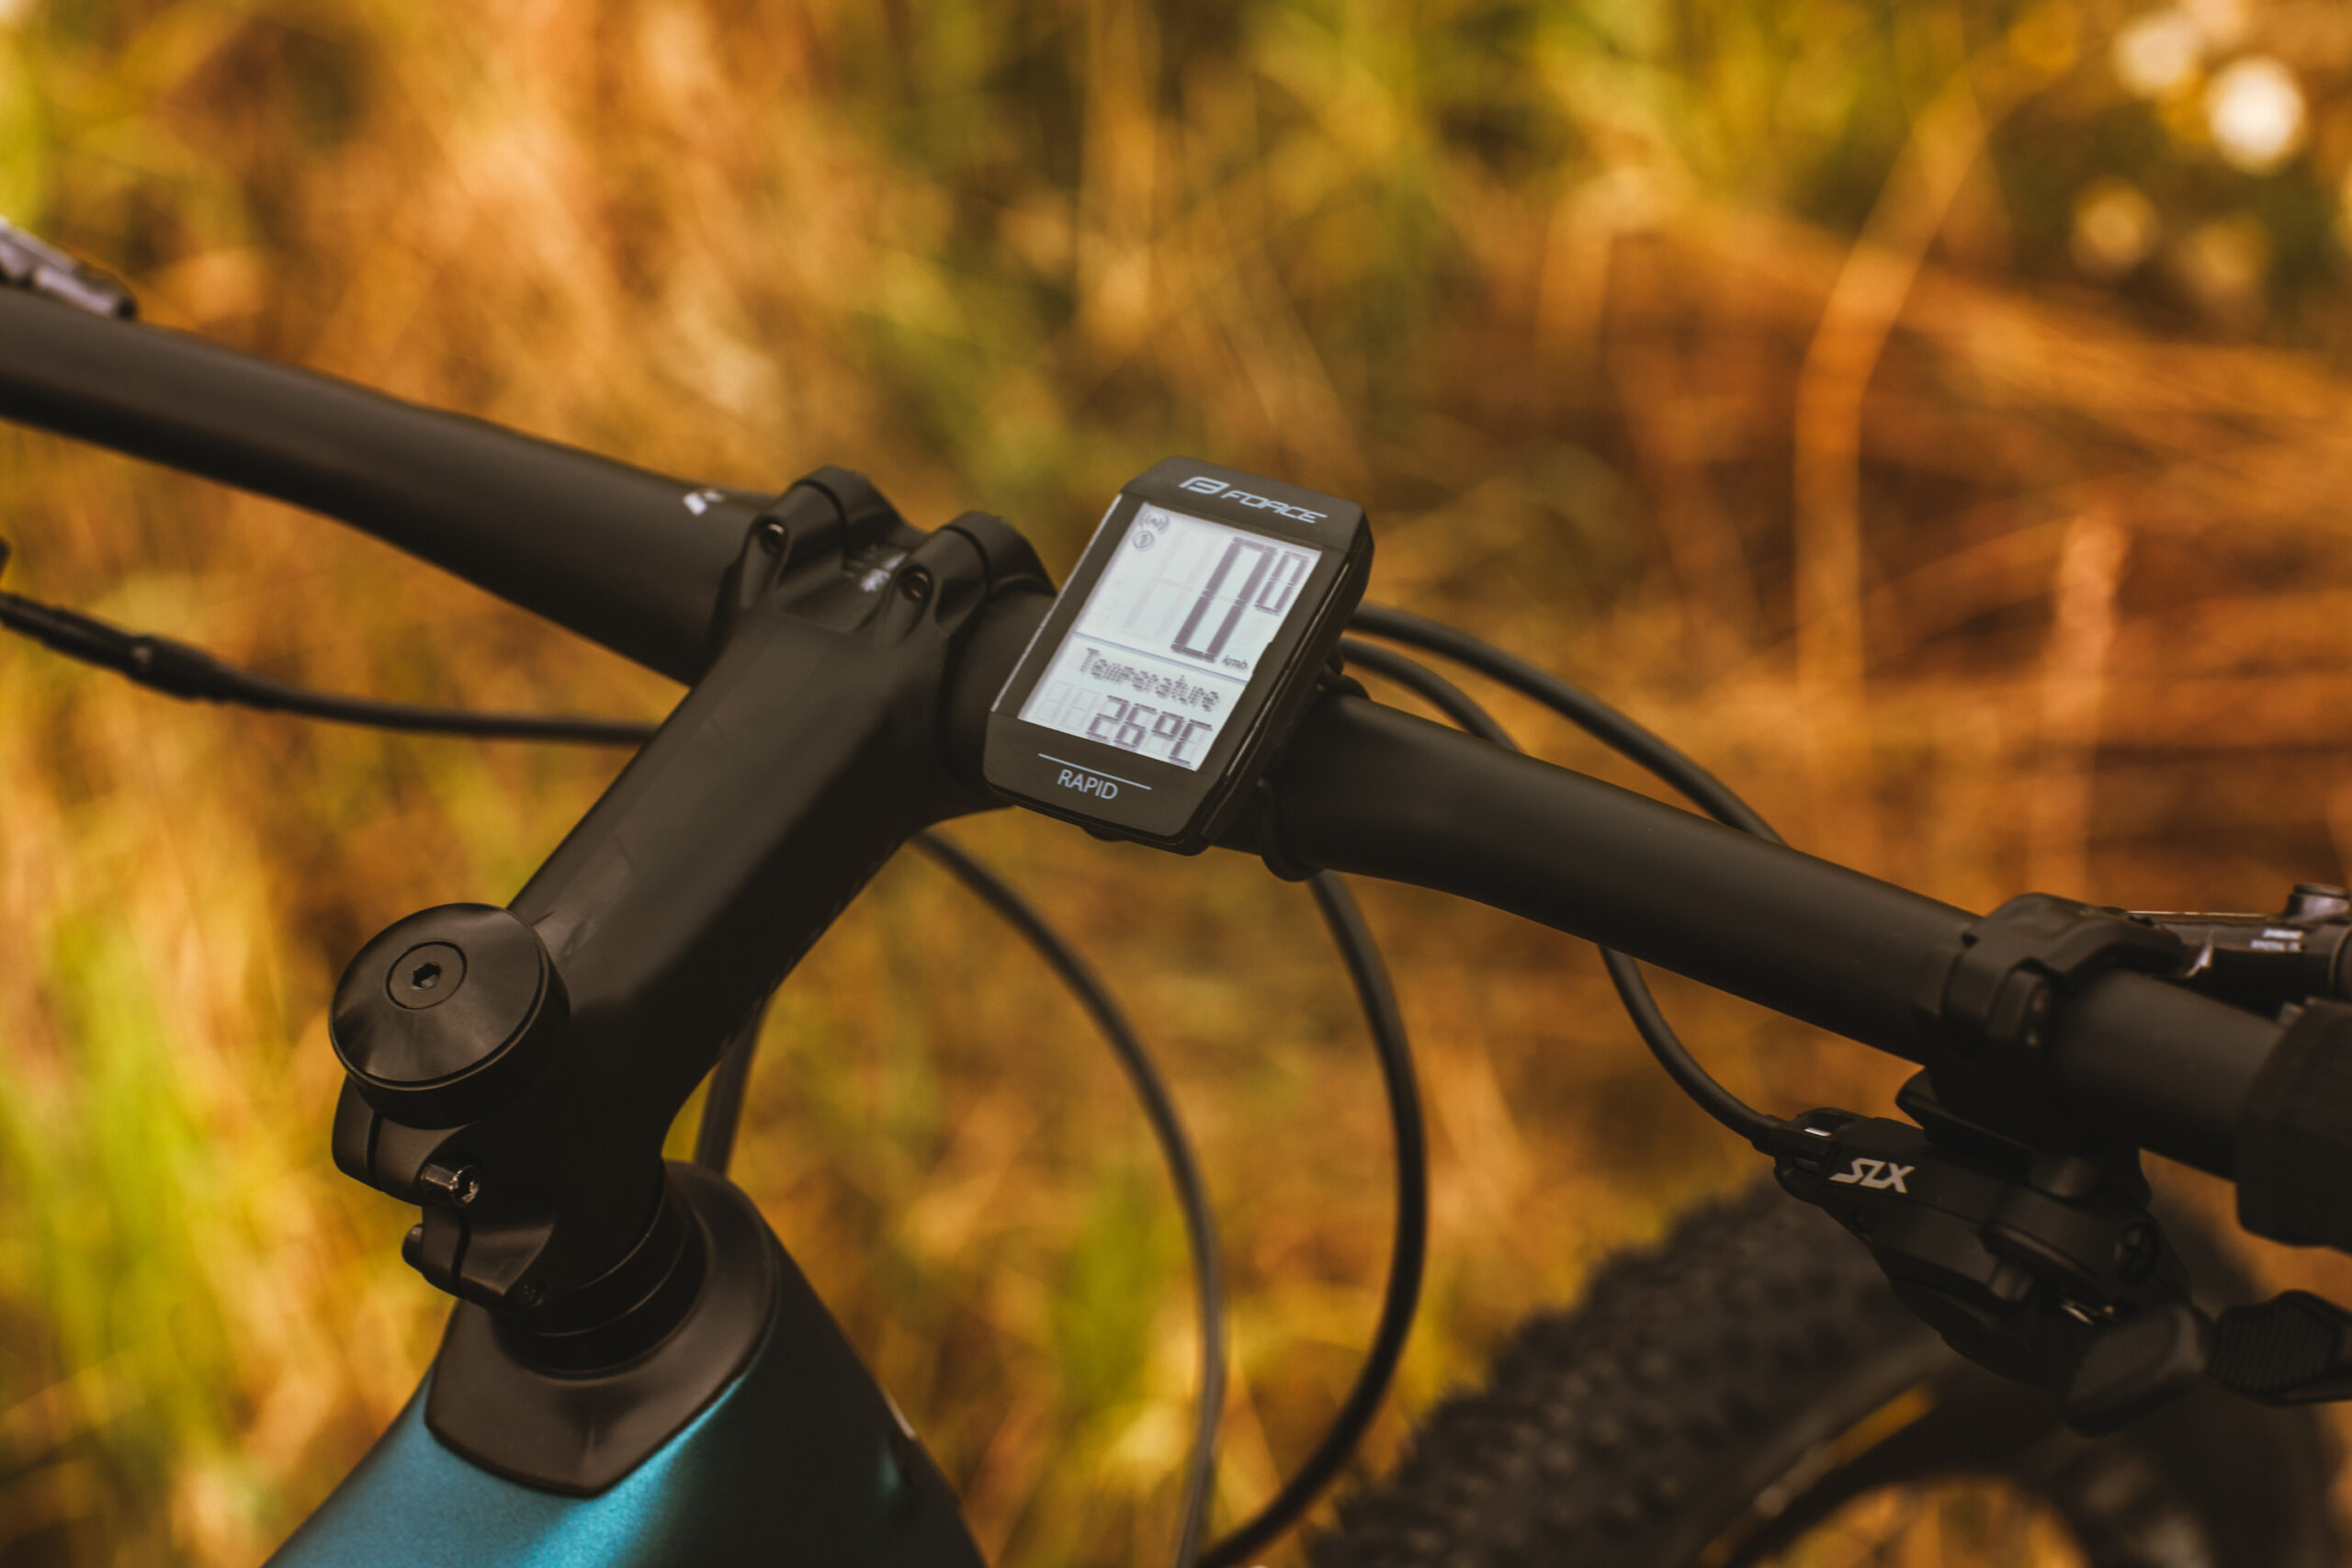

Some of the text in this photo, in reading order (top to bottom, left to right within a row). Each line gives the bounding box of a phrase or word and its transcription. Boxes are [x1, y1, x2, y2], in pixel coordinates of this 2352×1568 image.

[1220, 490, 1328, 524] FORCE
[1080, 648, 1219, 712] Temperature
[1057, 769, 1118, 799] RAPID
[1828, 1157, 1916, 1193] SLX
